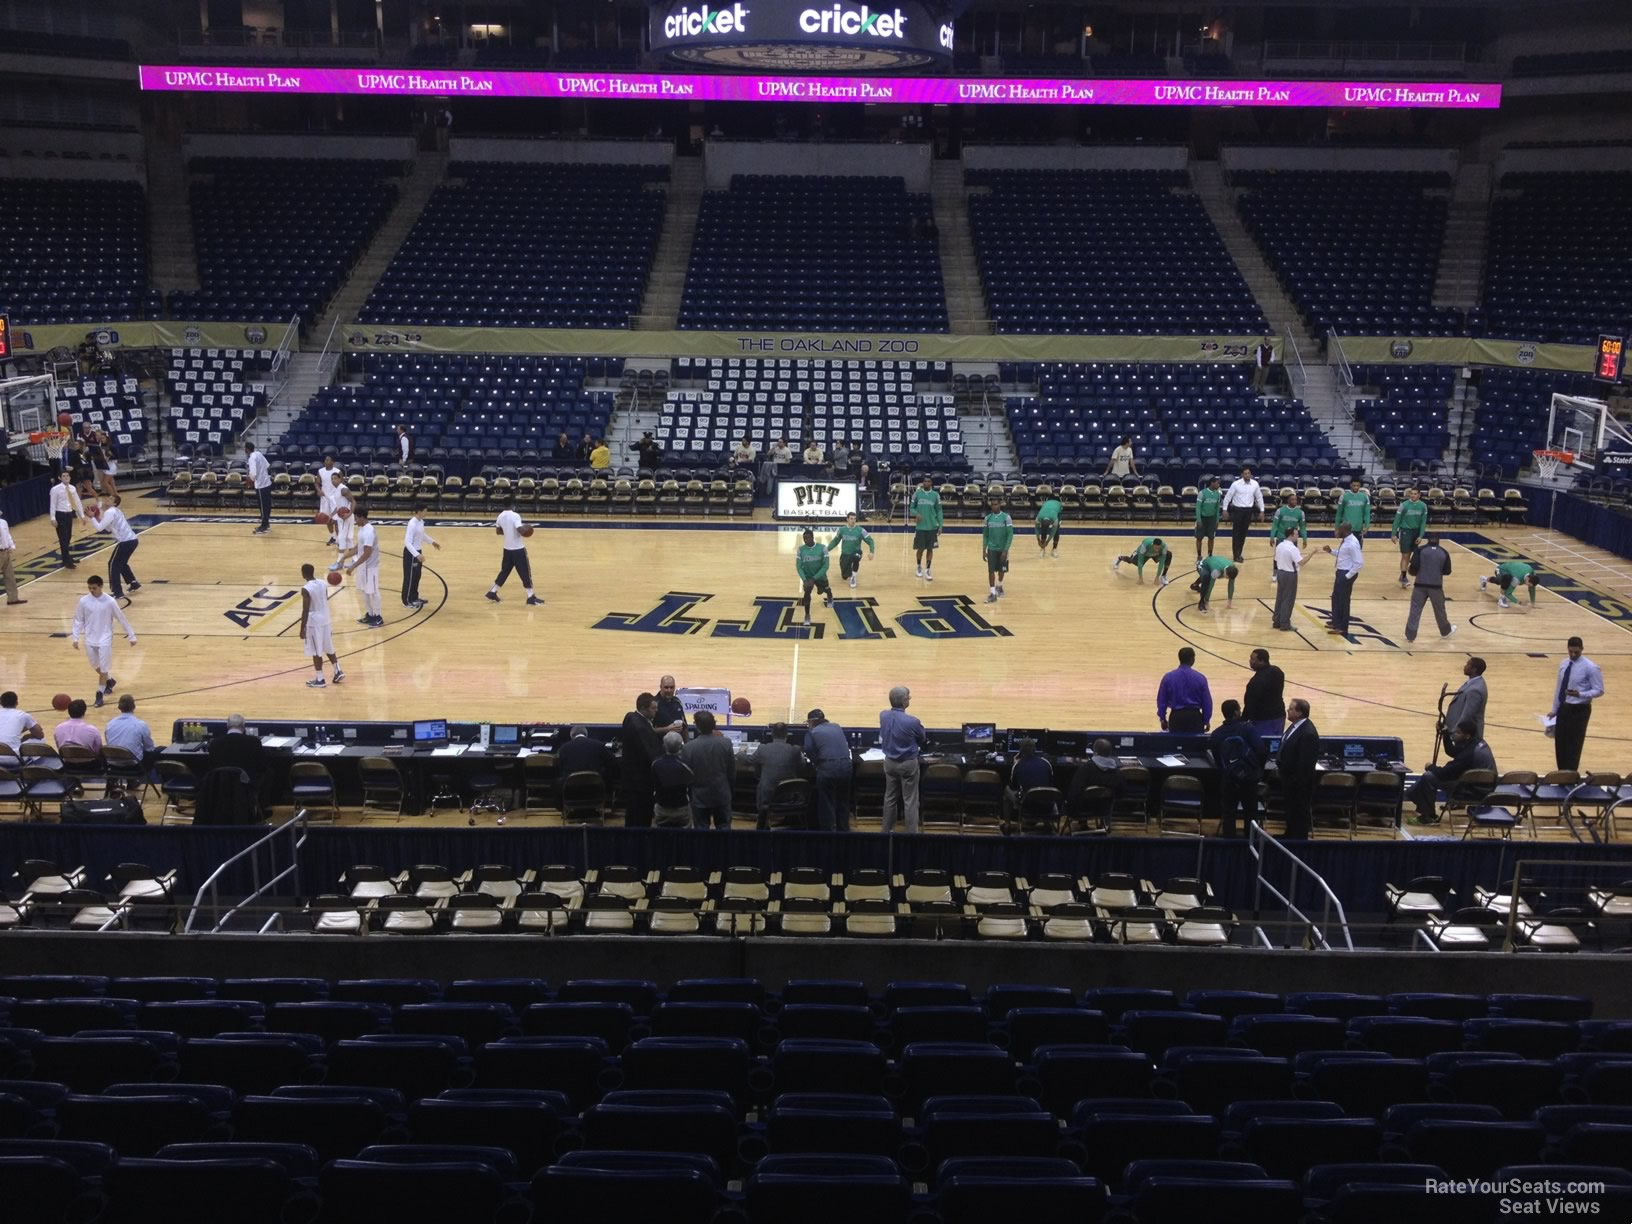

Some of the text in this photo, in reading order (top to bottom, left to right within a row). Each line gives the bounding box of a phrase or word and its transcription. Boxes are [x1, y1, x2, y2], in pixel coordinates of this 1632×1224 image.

[665, 3, 745, 38] cricket
[800, 4, 903, 38] cricket
[165, 72, 213, 86] UPMC
[358, 75, 405, 88] UPMC
[558, 78, 606, 92] UPMC
[758, 82, 805, 96] UPMC
[960, 84, 1006, 98] UPMC
[1154, 86, 1202, 100] UPMC
[1344, 88, 1392, 102] UPMC
[738, 338, 919, 352] THE OAKLAND ZOO
[793, 484, 840, 507] PITT
[224, 587, 298, 629] ACC
[591, 591, 1015, 640] PITT
[684, 703, 718, 711] SPALDING
